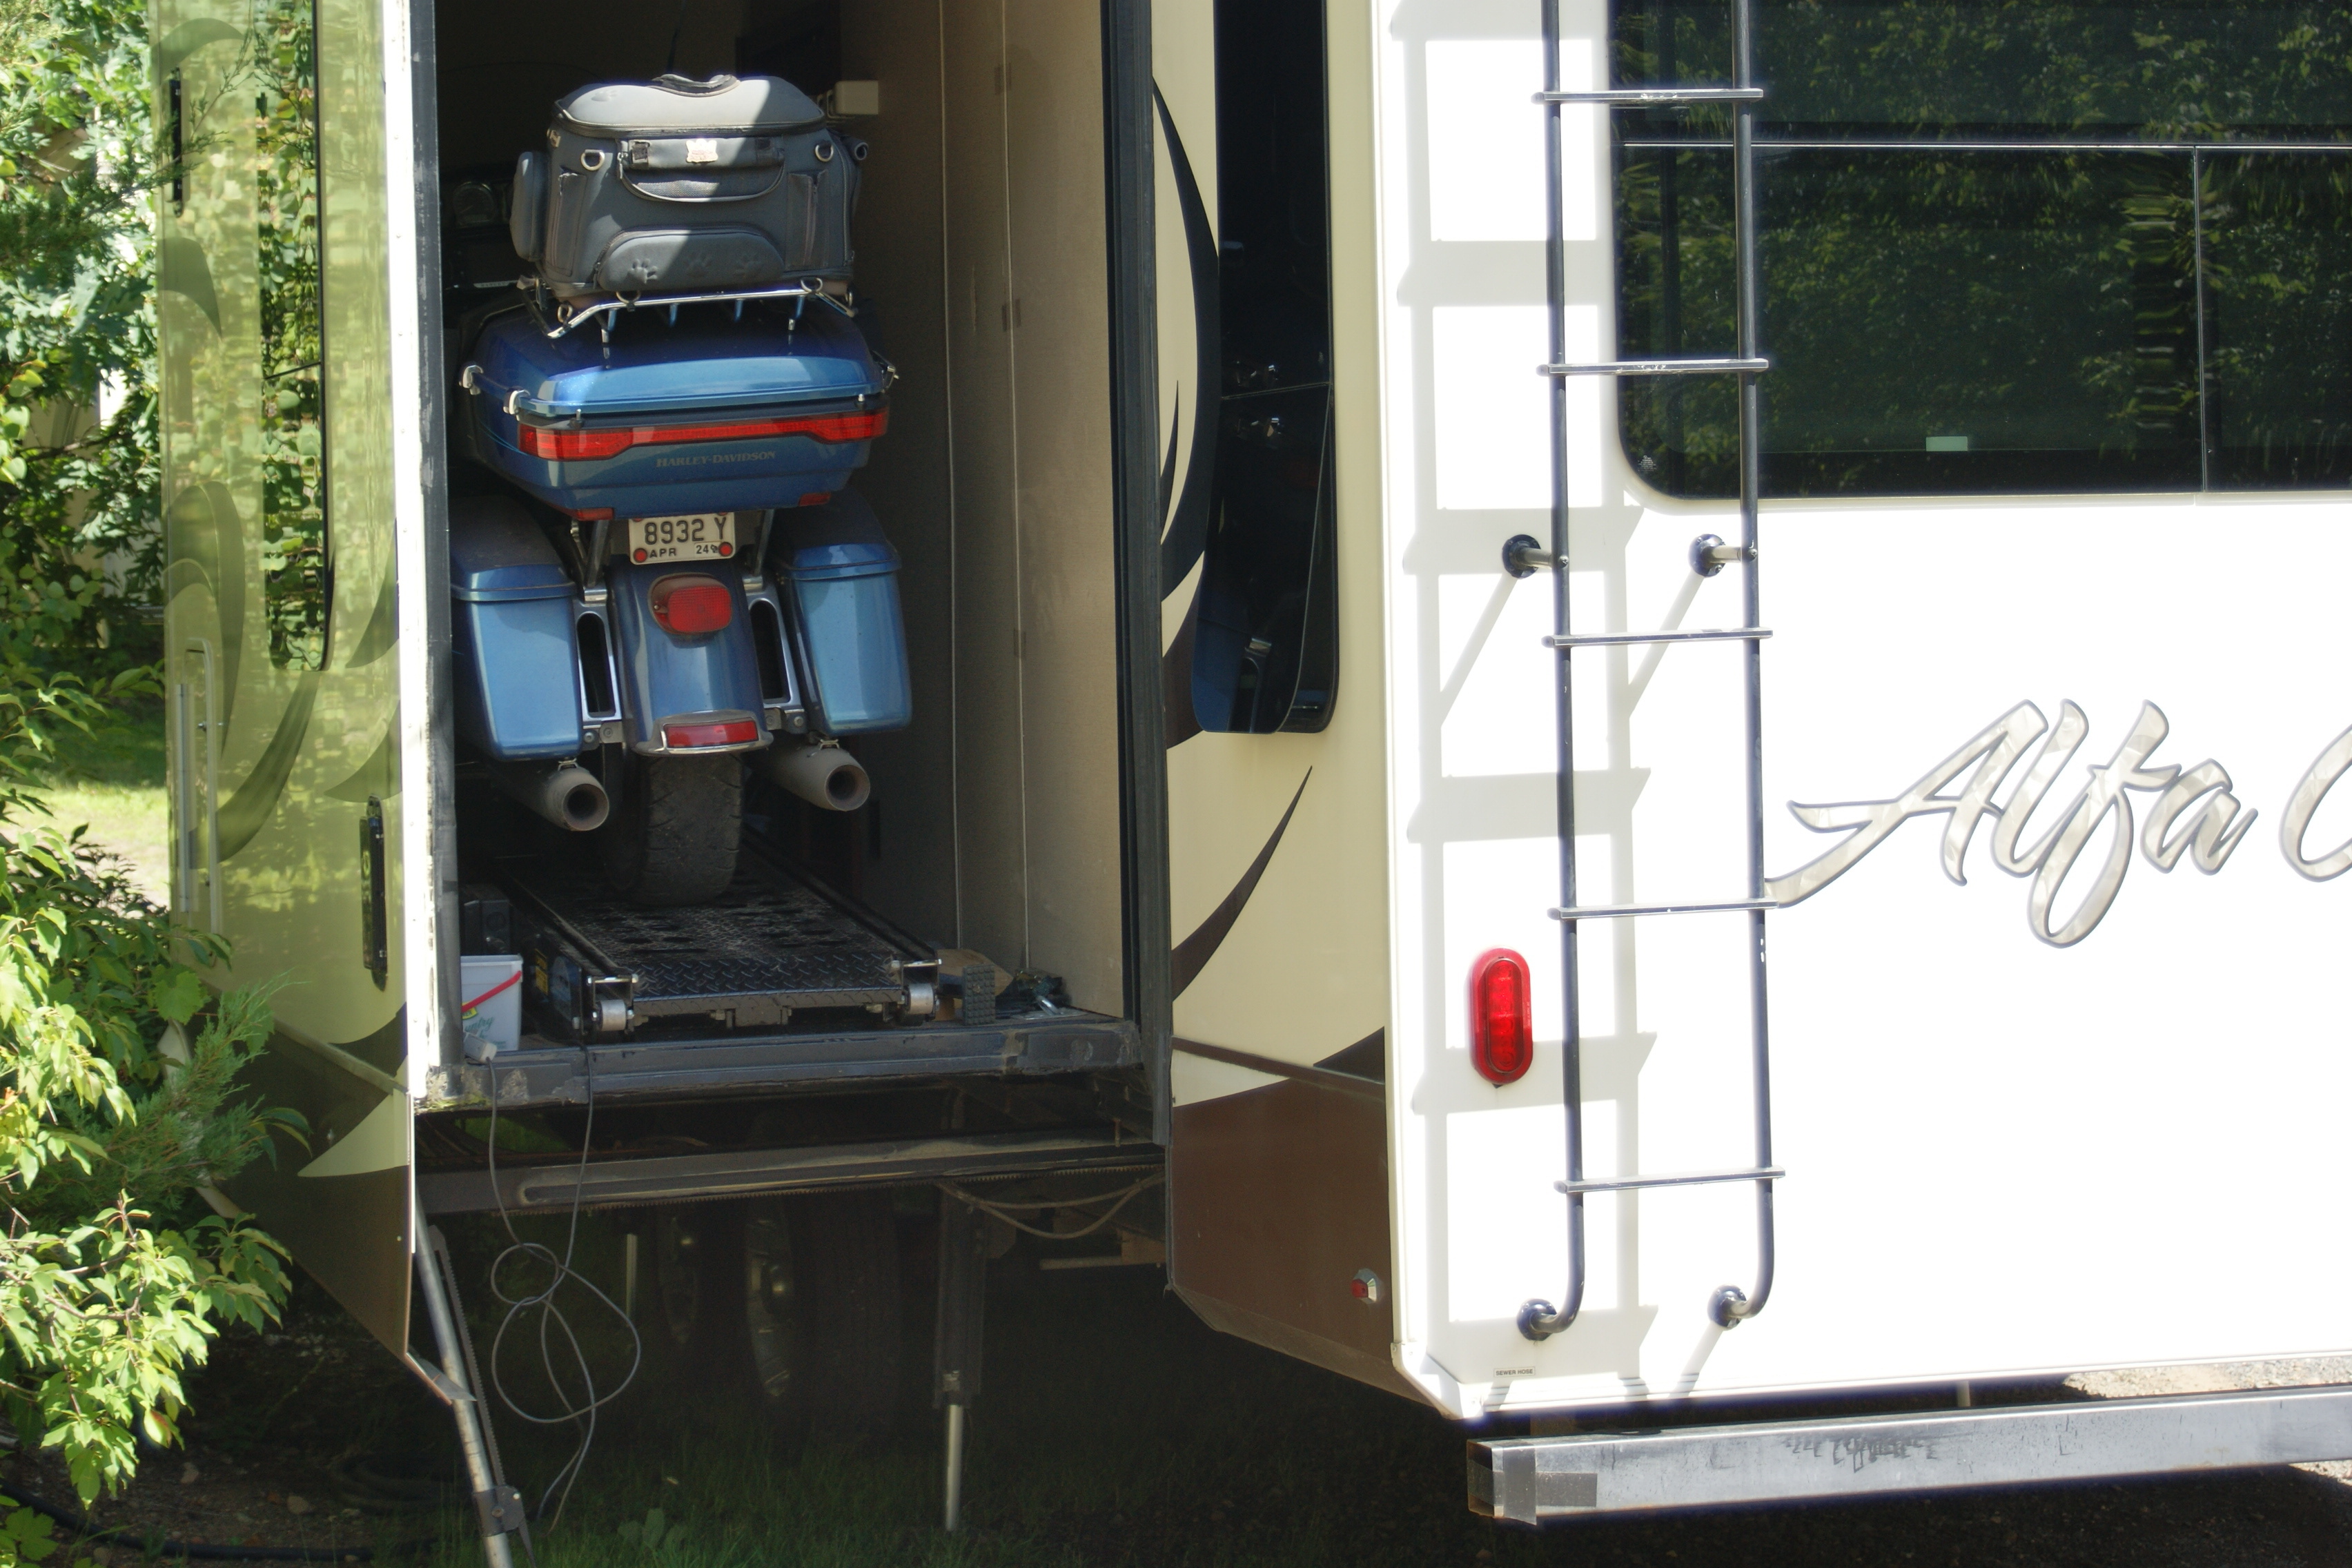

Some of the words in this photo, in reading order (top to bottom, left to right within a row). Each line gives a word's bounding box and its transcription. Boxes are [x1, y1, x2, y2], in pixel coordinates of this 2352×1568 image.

[656, 451, 775, 467] HARLEY-DAVIDSON
[645, 520, 704, 545] 8932
[714, 517, 726, 540] Y
[649, 548, 676, 558] APR
[696, 545, 709, 554] 24
[1764, 698, 2259, 949] Alfa
